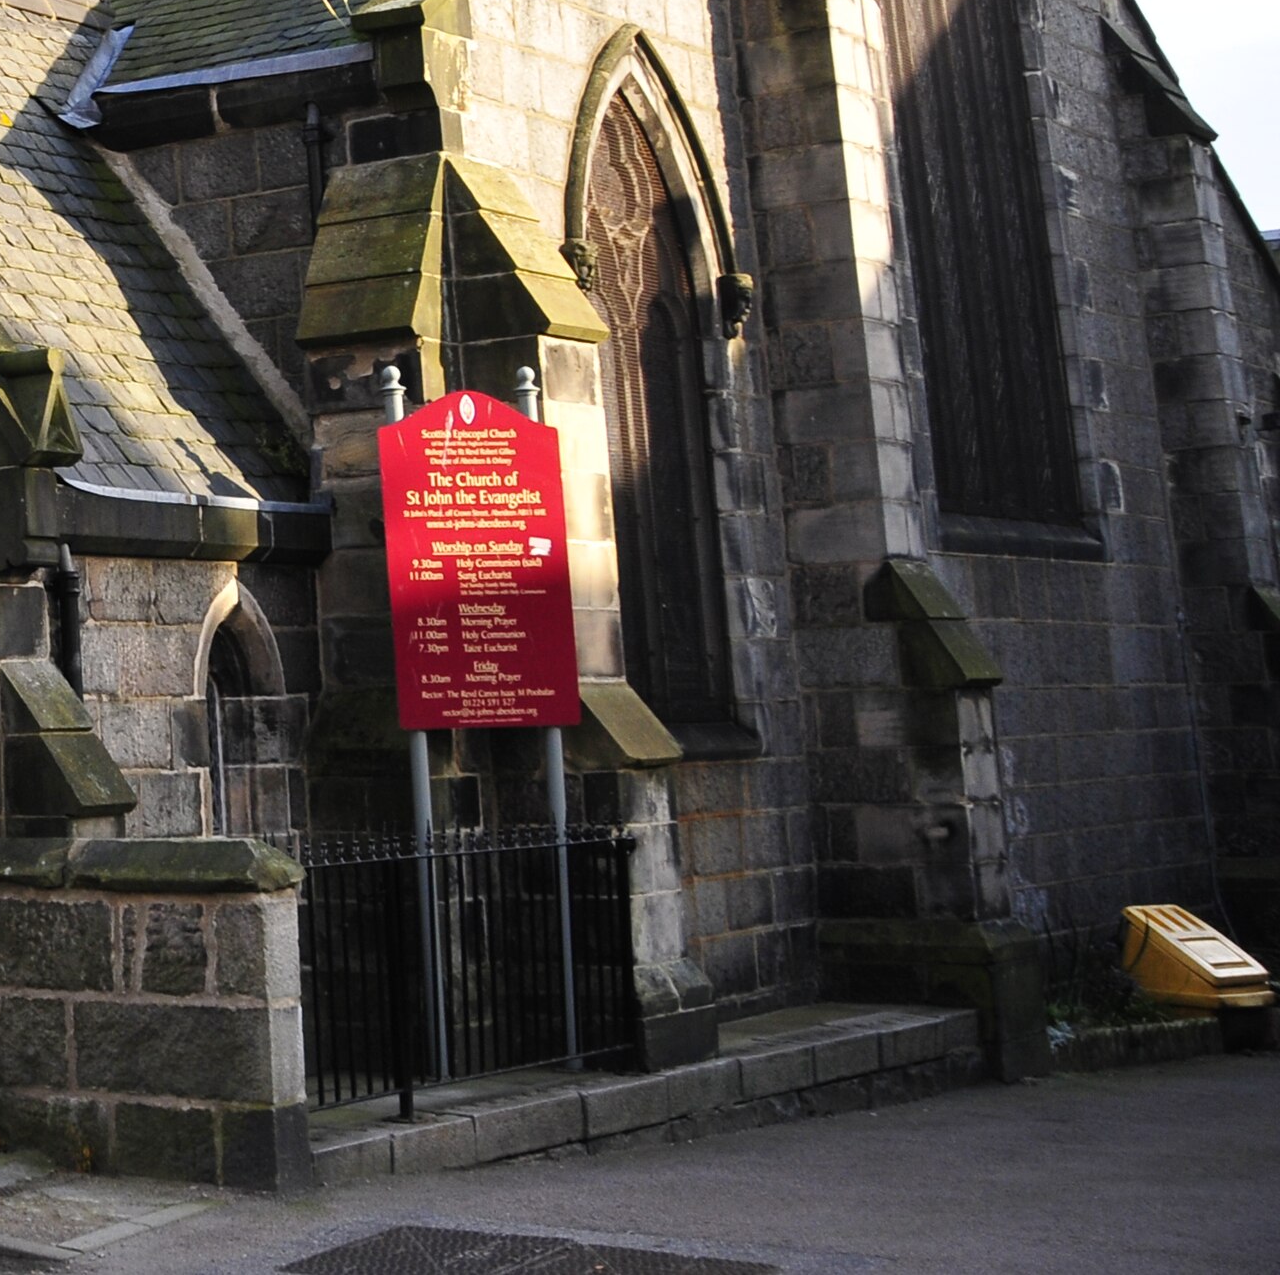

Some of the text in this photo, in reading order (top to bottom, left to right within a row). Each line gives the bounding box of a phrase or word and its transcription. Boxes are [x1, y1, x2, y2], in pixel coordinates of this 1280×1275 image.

[453, 429, 488, 440] Episcopal
[489, 428, 517, 439] Church
[427, 471, 519, 487] The Church of
[406, 489, 542, 509] St John the Evangelist
[431, 540, 524, 556] Worship on Sunday
[412, 557, 542, 570] 9.30am Holy Communion (said)
[409, 570, 512, 582] 11.00am Sung Eucharist
[458, 602, 506, 616] Wednesday
[417, 617, 517, 628] 8.30am Morning Prayer
[413, 630, 526, 642] 11.00am Holy Communion
[419, 644, 449, 655] 7.30pm
[484, 643, 518, 652] Eucharist
[473, 660, 499, 674] Friday
[421, 672, 522, 685] 8.30am Morning Prayer
[447, 690, 459, 698] The
[462, 699, 485, 707] 01224
